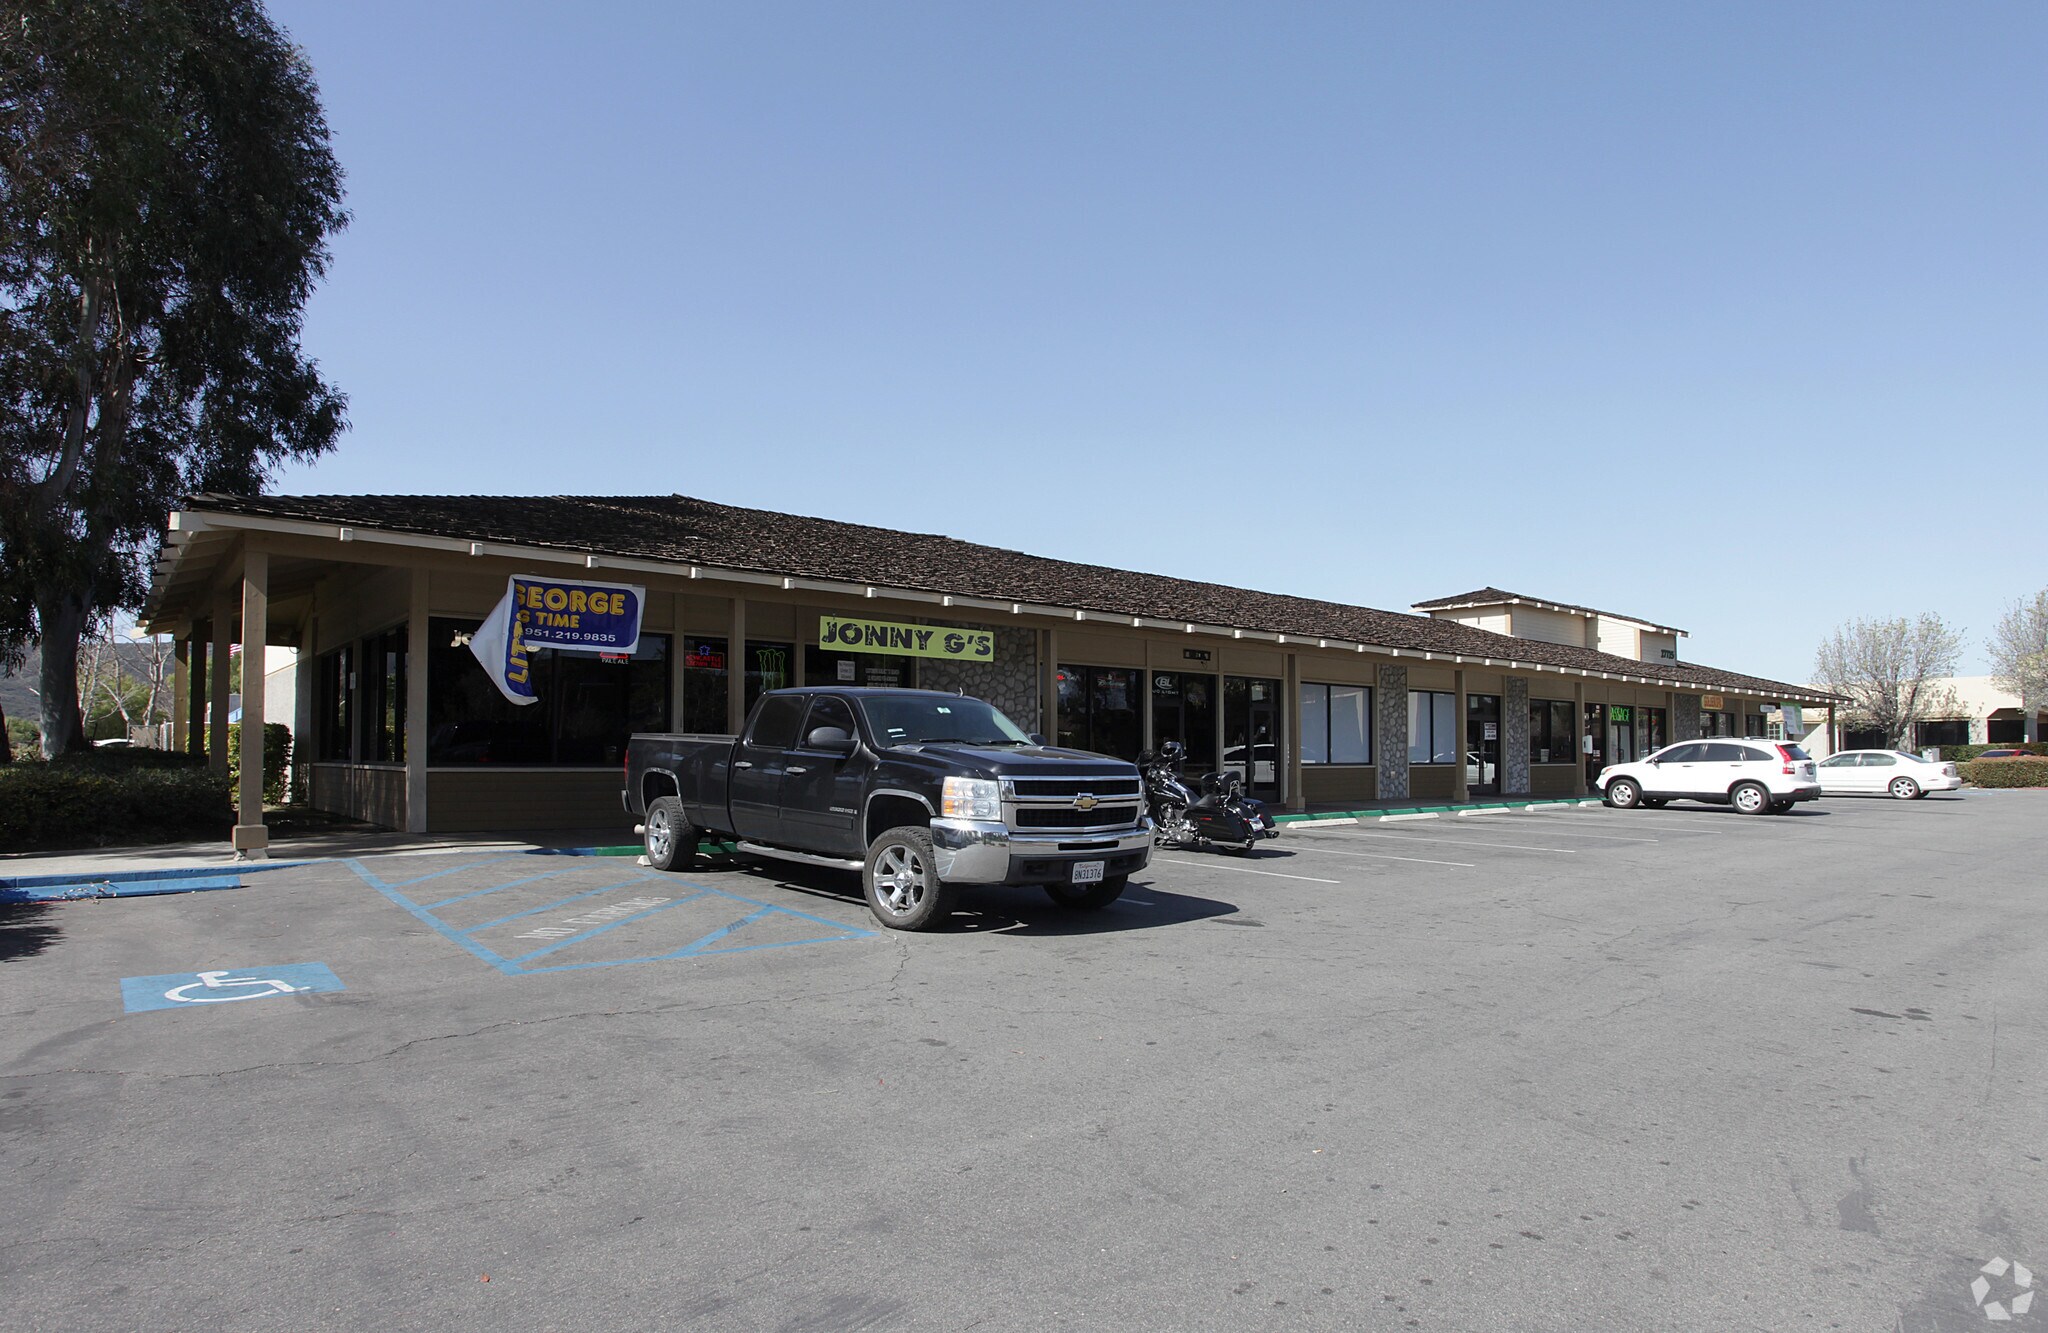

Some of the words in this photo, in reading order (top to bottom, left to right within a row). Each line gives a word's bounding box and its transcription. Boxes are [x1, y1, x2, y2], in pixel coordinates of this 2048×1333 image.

[535, 612, 580, 628] TIME
[525, 627, 616, 642] 951.219.9835
[821, 621, 934, 650] JONNY
[943, 633, 992, 656] G'S
[1160, 677, 1173, 687] BL
[1610, 706, 1631, 722] ASSAGE
[1074, 869, 1102, 880] 8N31376
[513, 926, 578, 940] NO
[562, 896, 671, 924] PARKING
